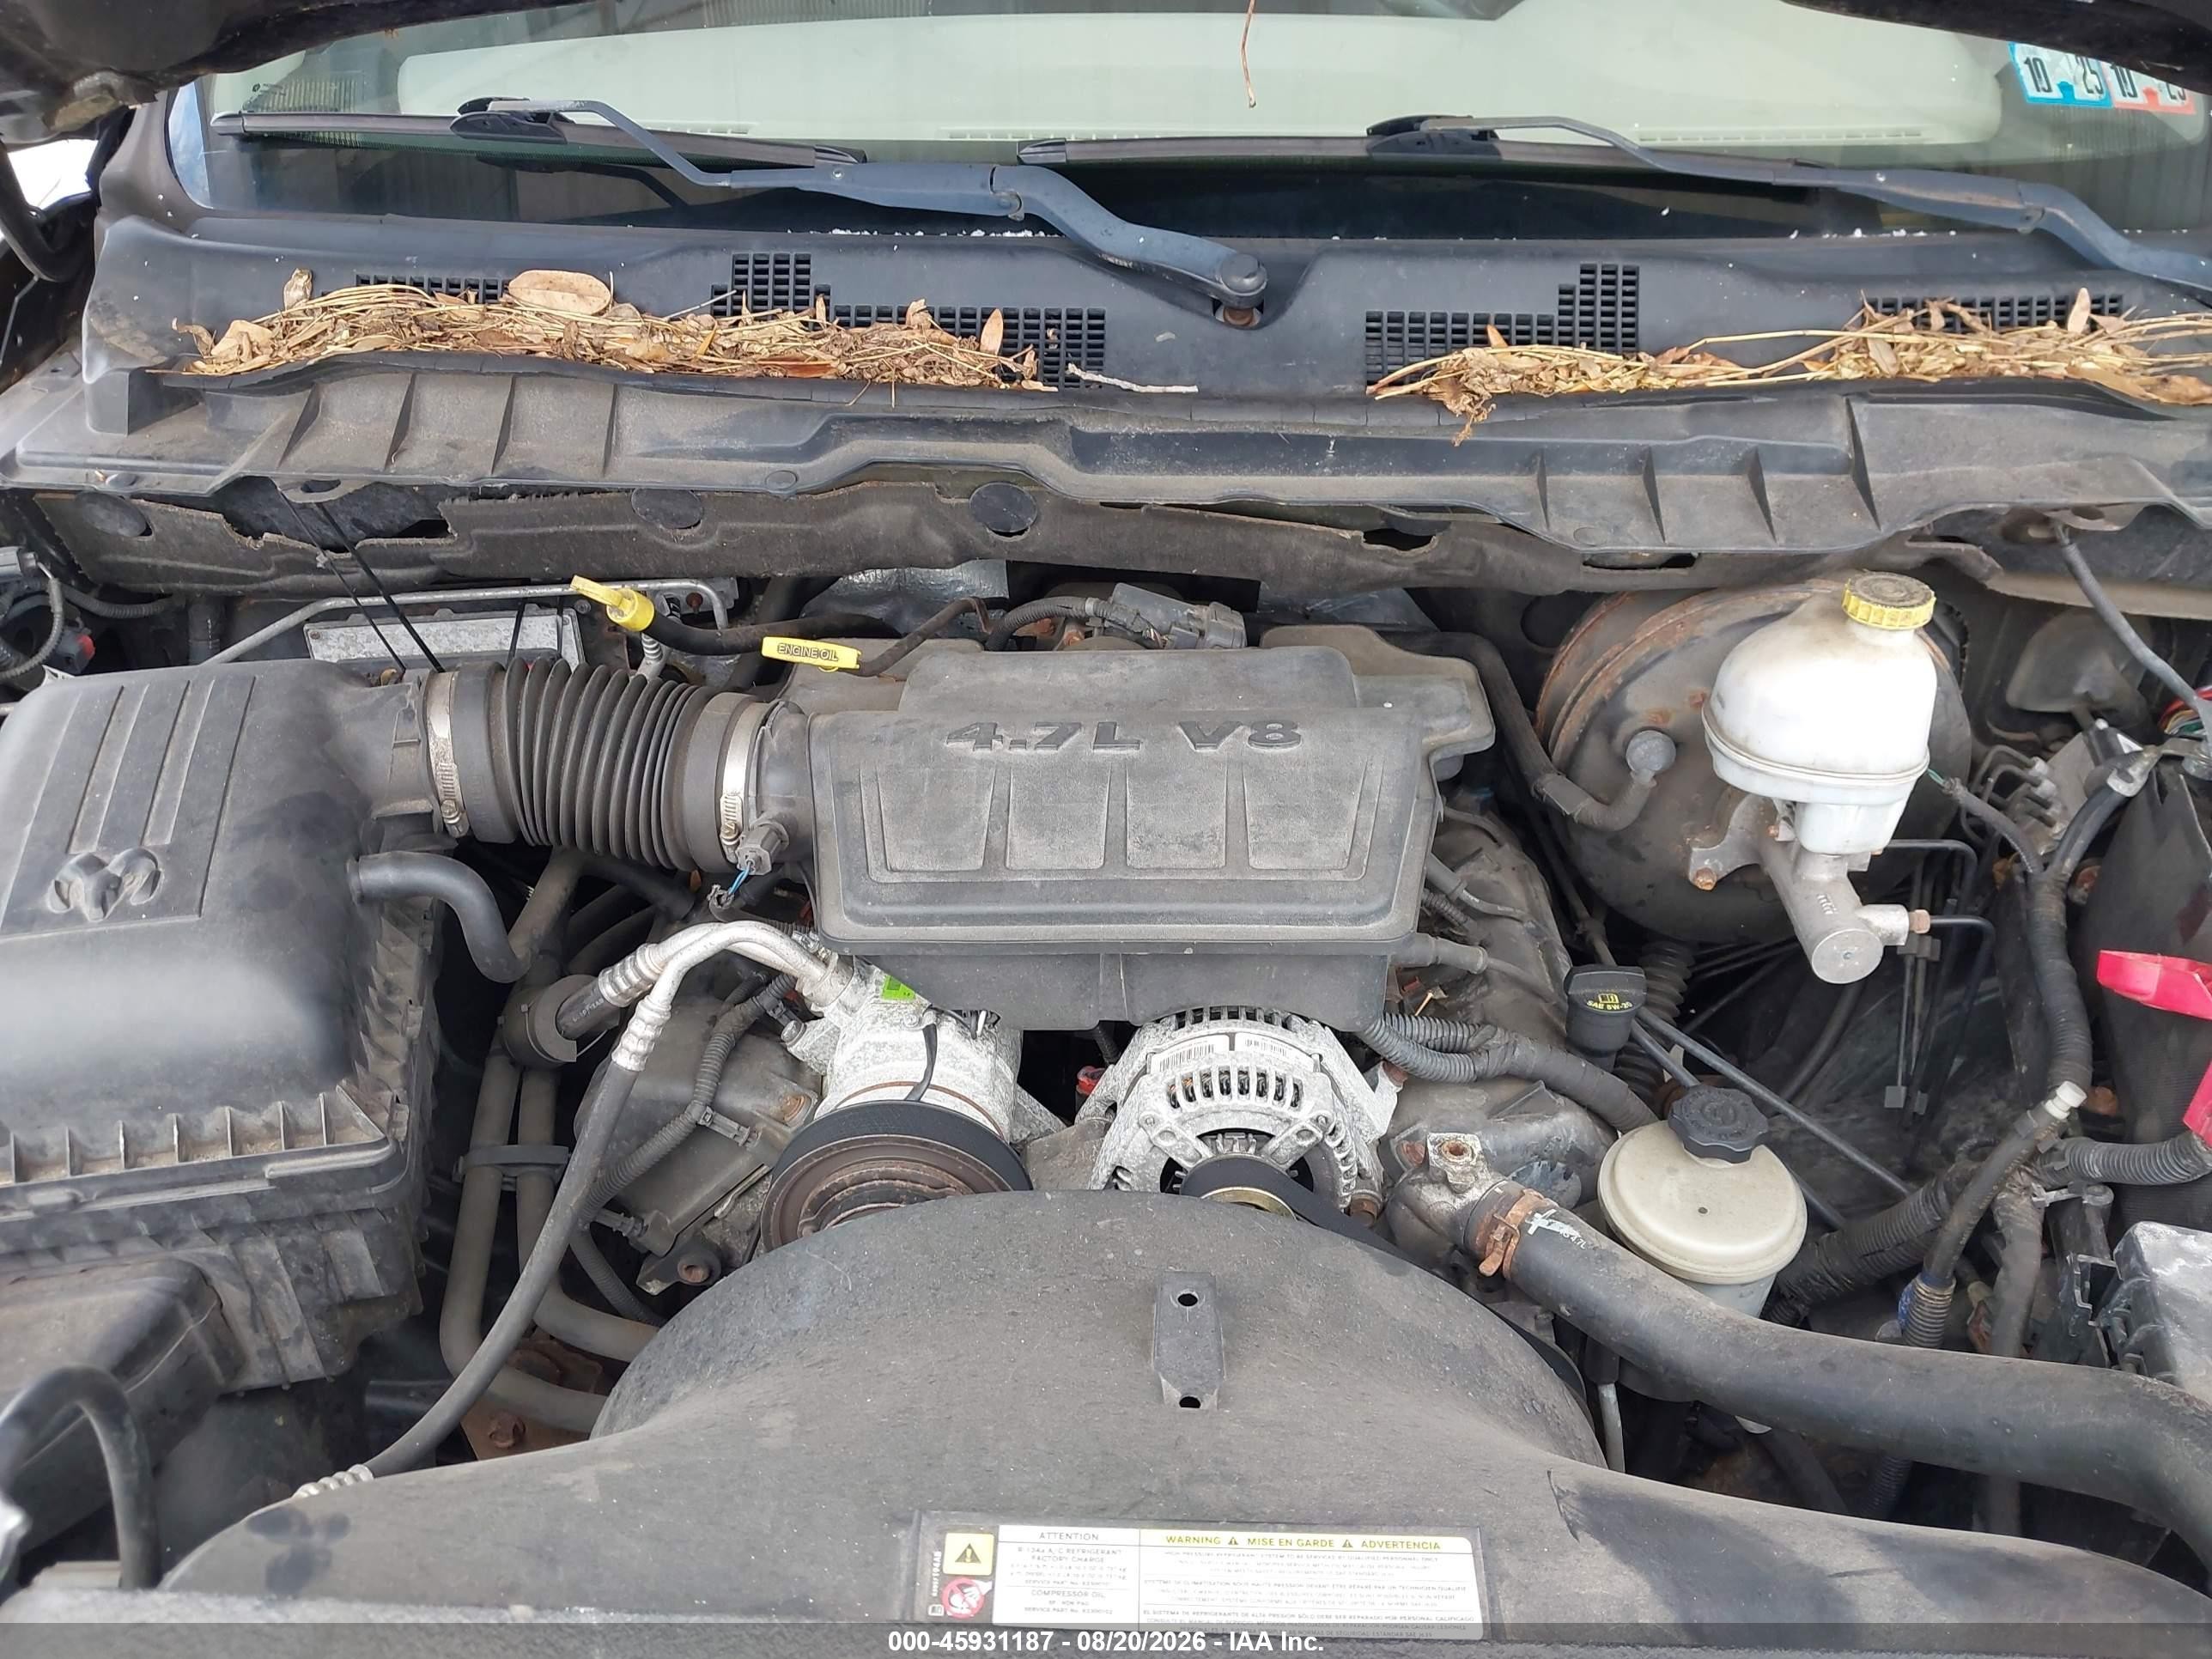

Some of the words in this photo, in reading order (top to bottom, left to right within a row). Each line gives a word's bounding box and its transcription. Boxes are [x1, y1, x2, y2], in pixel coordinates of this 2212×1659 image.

[2024, 57, 2053, 93] 10
[777, 643, 818, 659] ENGINE
[819, 648, 839, 661] OIL
[946, 720, 1141, 752] 4.7L
[1178, 720, 1302, 751] V8
[1586, 1000, 1605, 1010] SAE
[1606, 1001, 1633, 1011] 5W-20
[1038, 1532, 1100, 1541] ATTENTION
[1165, 1535, 1222, 1545] WARNING
[1247, 1537, 1275, 1547] MISE
[1279, 1538, 1293, 1547] EN
[1297, 1538, 1335, 1547] GARDE
[1360, 1540, 1442, 1550] ADVERTENCIA
[1030, 1589, 1089, 1597] COMPRESSOR
